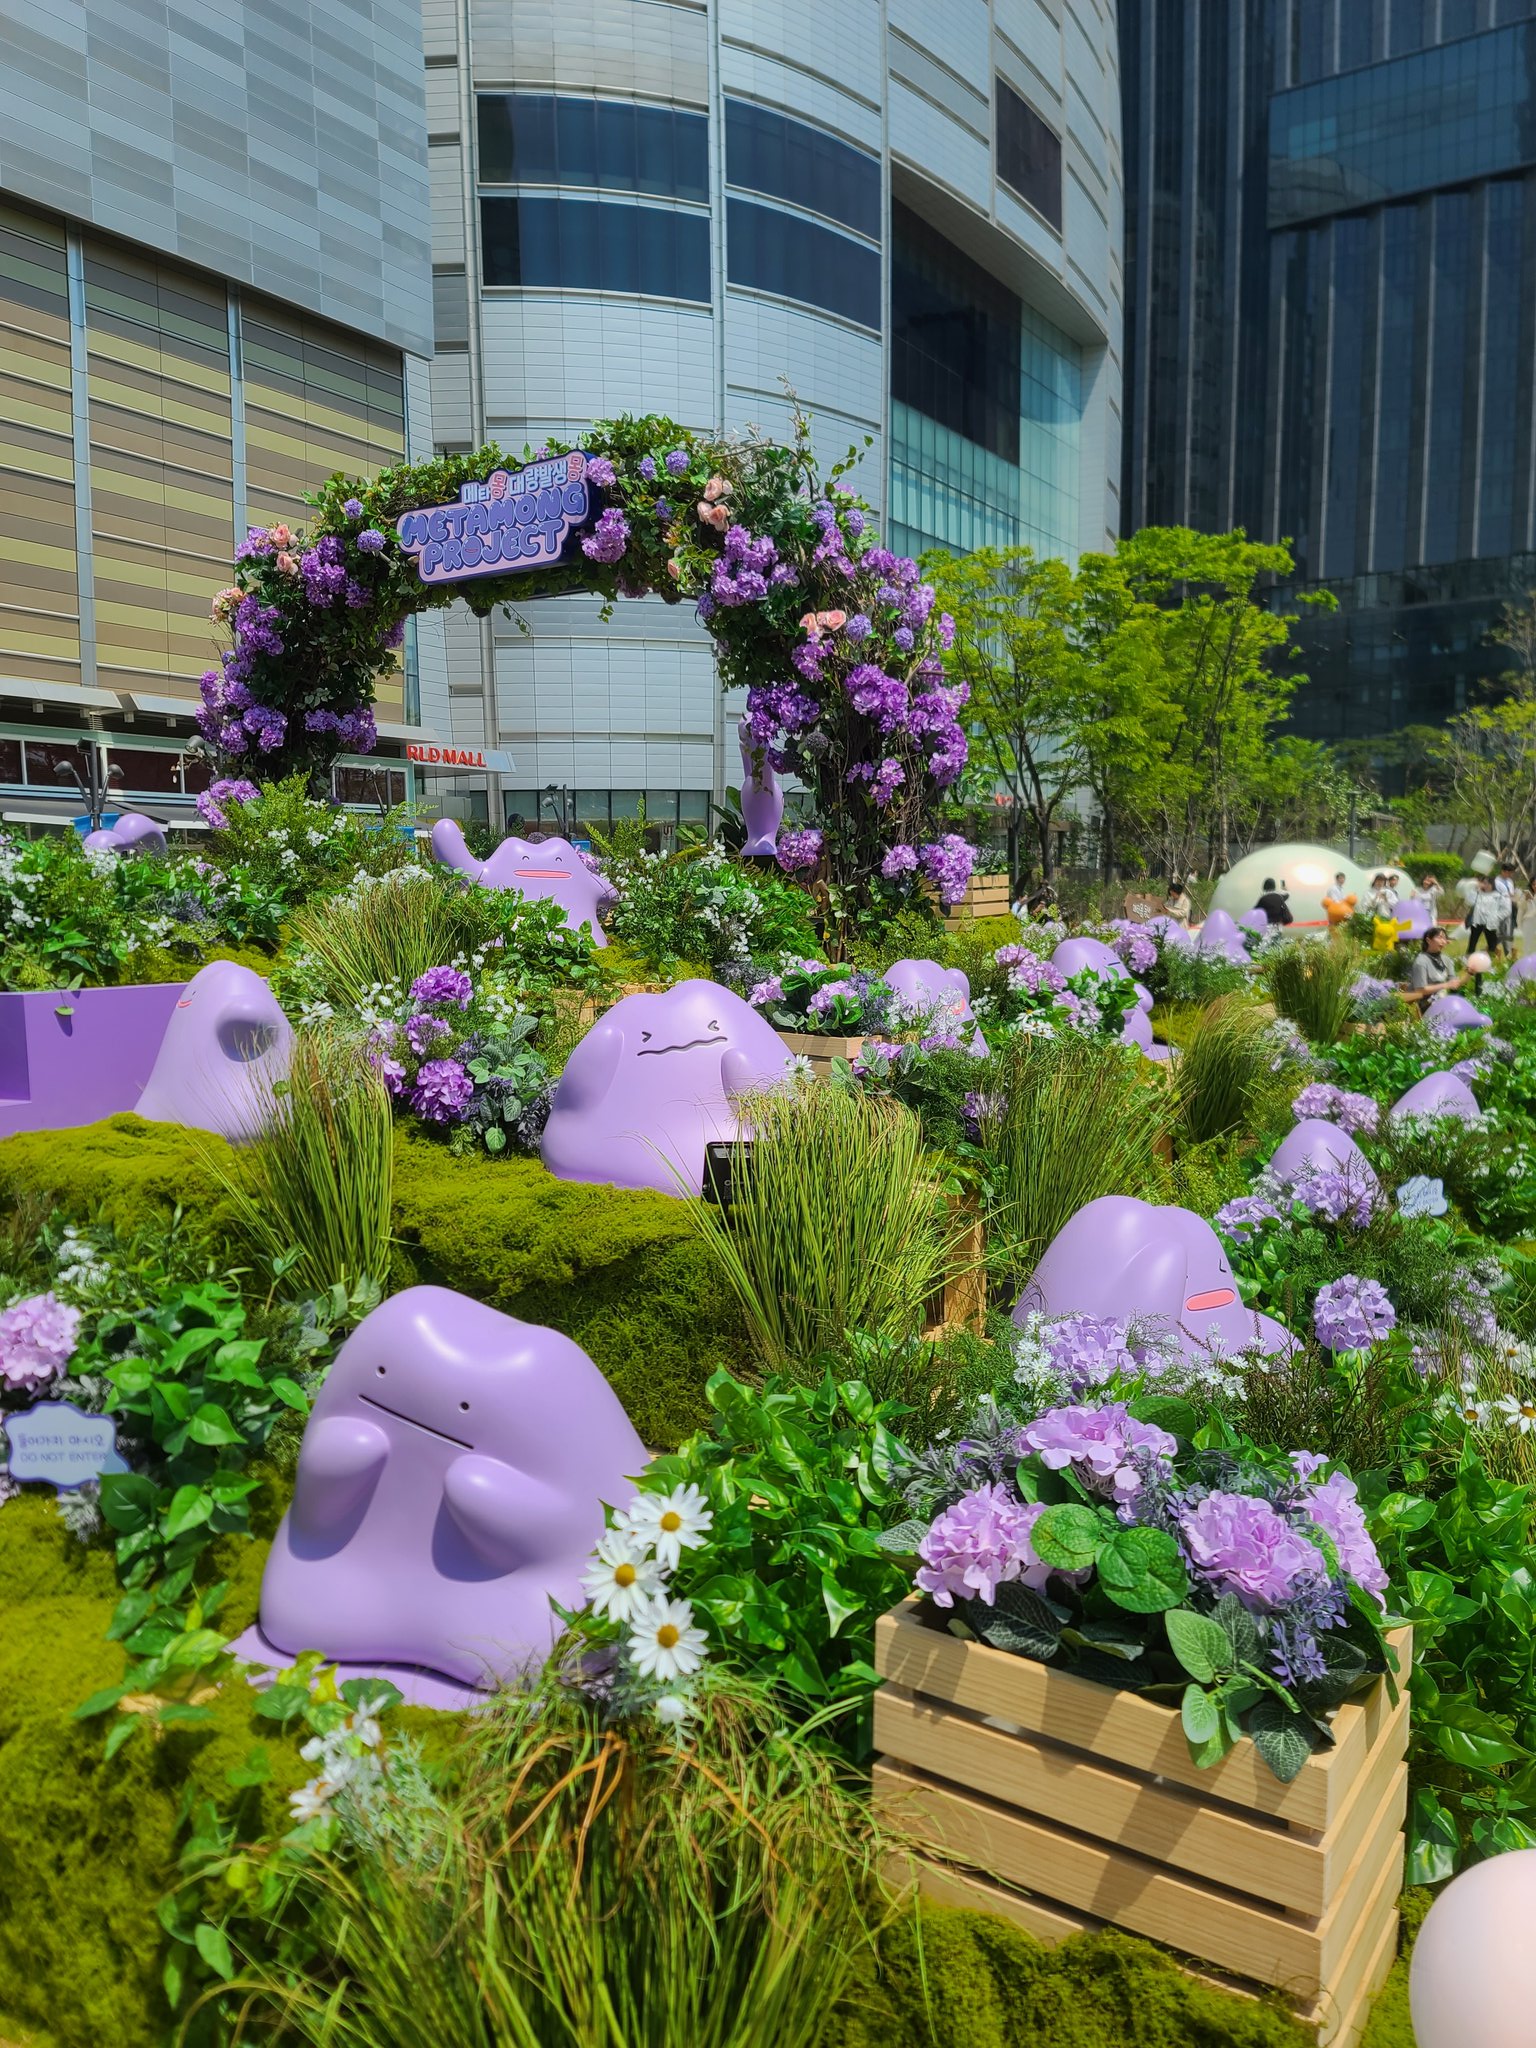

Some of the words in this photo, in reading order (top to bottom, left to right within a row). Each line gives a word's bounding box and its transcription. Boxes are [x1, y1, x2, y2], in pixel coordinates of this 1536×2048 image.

[463, 473, 507, 504] 메타몽
[401, 482, 587, 548] METAMONG
[423, 519, 564, 575] PROJECT
[443, 749, 487, 768] MALL
[20, 1452, 37, 1462] DO
[41, 1452, 65, 1462] NOT
[69, 1452, 106, 1463] ENTER
